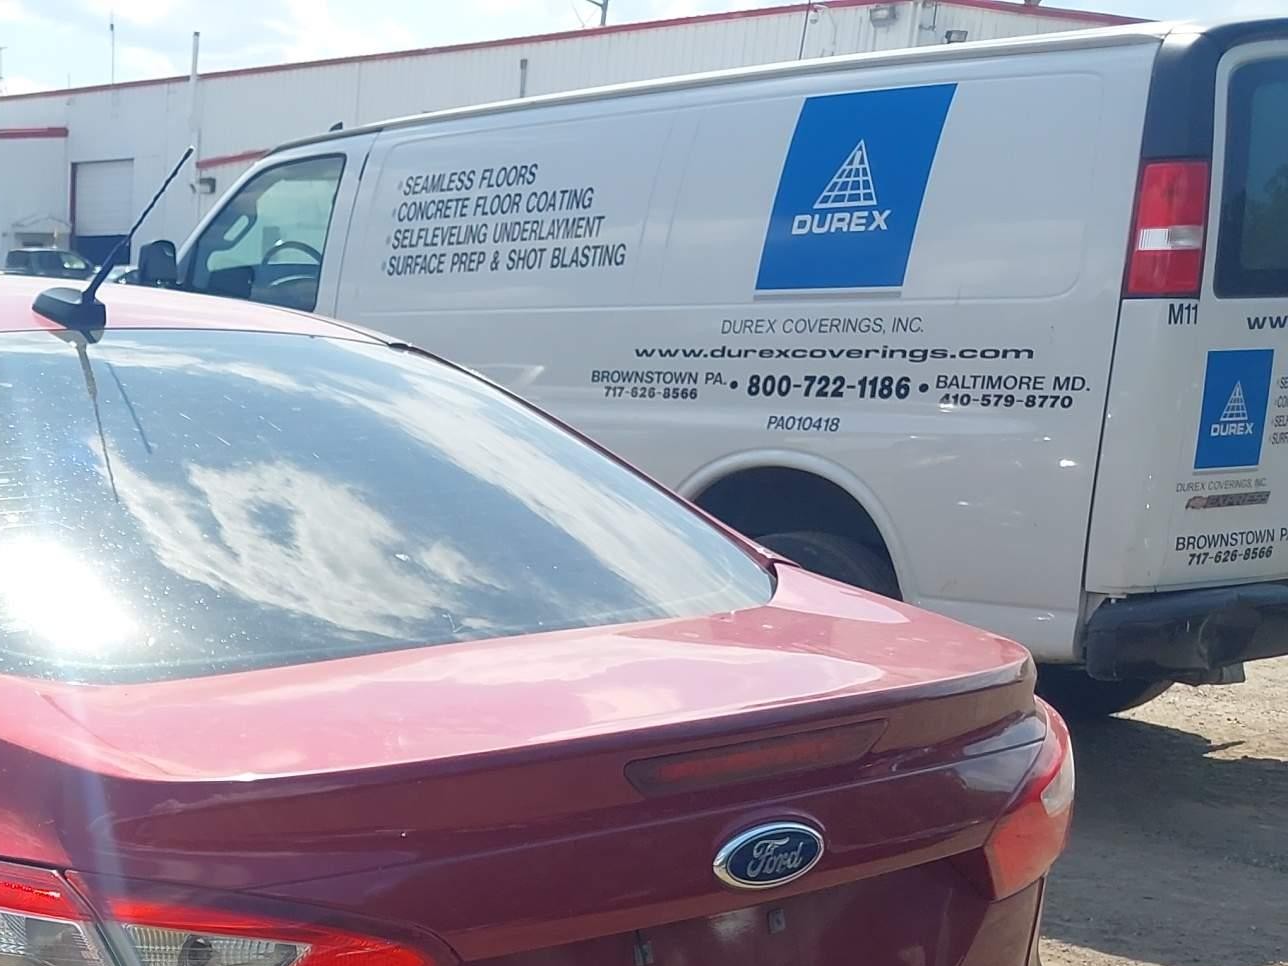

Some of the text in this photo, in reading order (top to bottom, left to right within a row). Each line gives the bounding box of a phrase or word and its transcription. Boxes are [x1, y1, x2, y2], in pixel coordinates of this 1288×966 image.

[403, 163, 538, 196] SEAMLESS FLOORS
[398, 187, 594, 222] CONCRETE FLOOR COATING
[392, 216, 605, 249] SELFLEVELING UNDERLAYMENT
[792, 210, 891, 234] DUREX
[387, 243, 626, 276] SURFACE PREP & SHOT BLASTING
[1168, 303, 1198, 325] M11
[721, 317, 924, 334] DUREX COVERINGS, INC.
[635, 345, 1034, 362] www.durexcoverings.com
[591, 370, 727, 385] BROWNSTOWN PA.
[747, 373, 911, 399] 800-722-1186
[935, 375, 1091, 392] BALTIMORE MD.
[603, 386, 698, 400] 717-626-8566
[938, 393, 1073, 409] 410-579-8770
[1210, 423, 1254, 437] DUREX
[1176, 528, 1274, 551] BROWNSTOWN
[1188, 546, 1273, 566] 717-626-8566
[747, 836, 804, 878] Ford
